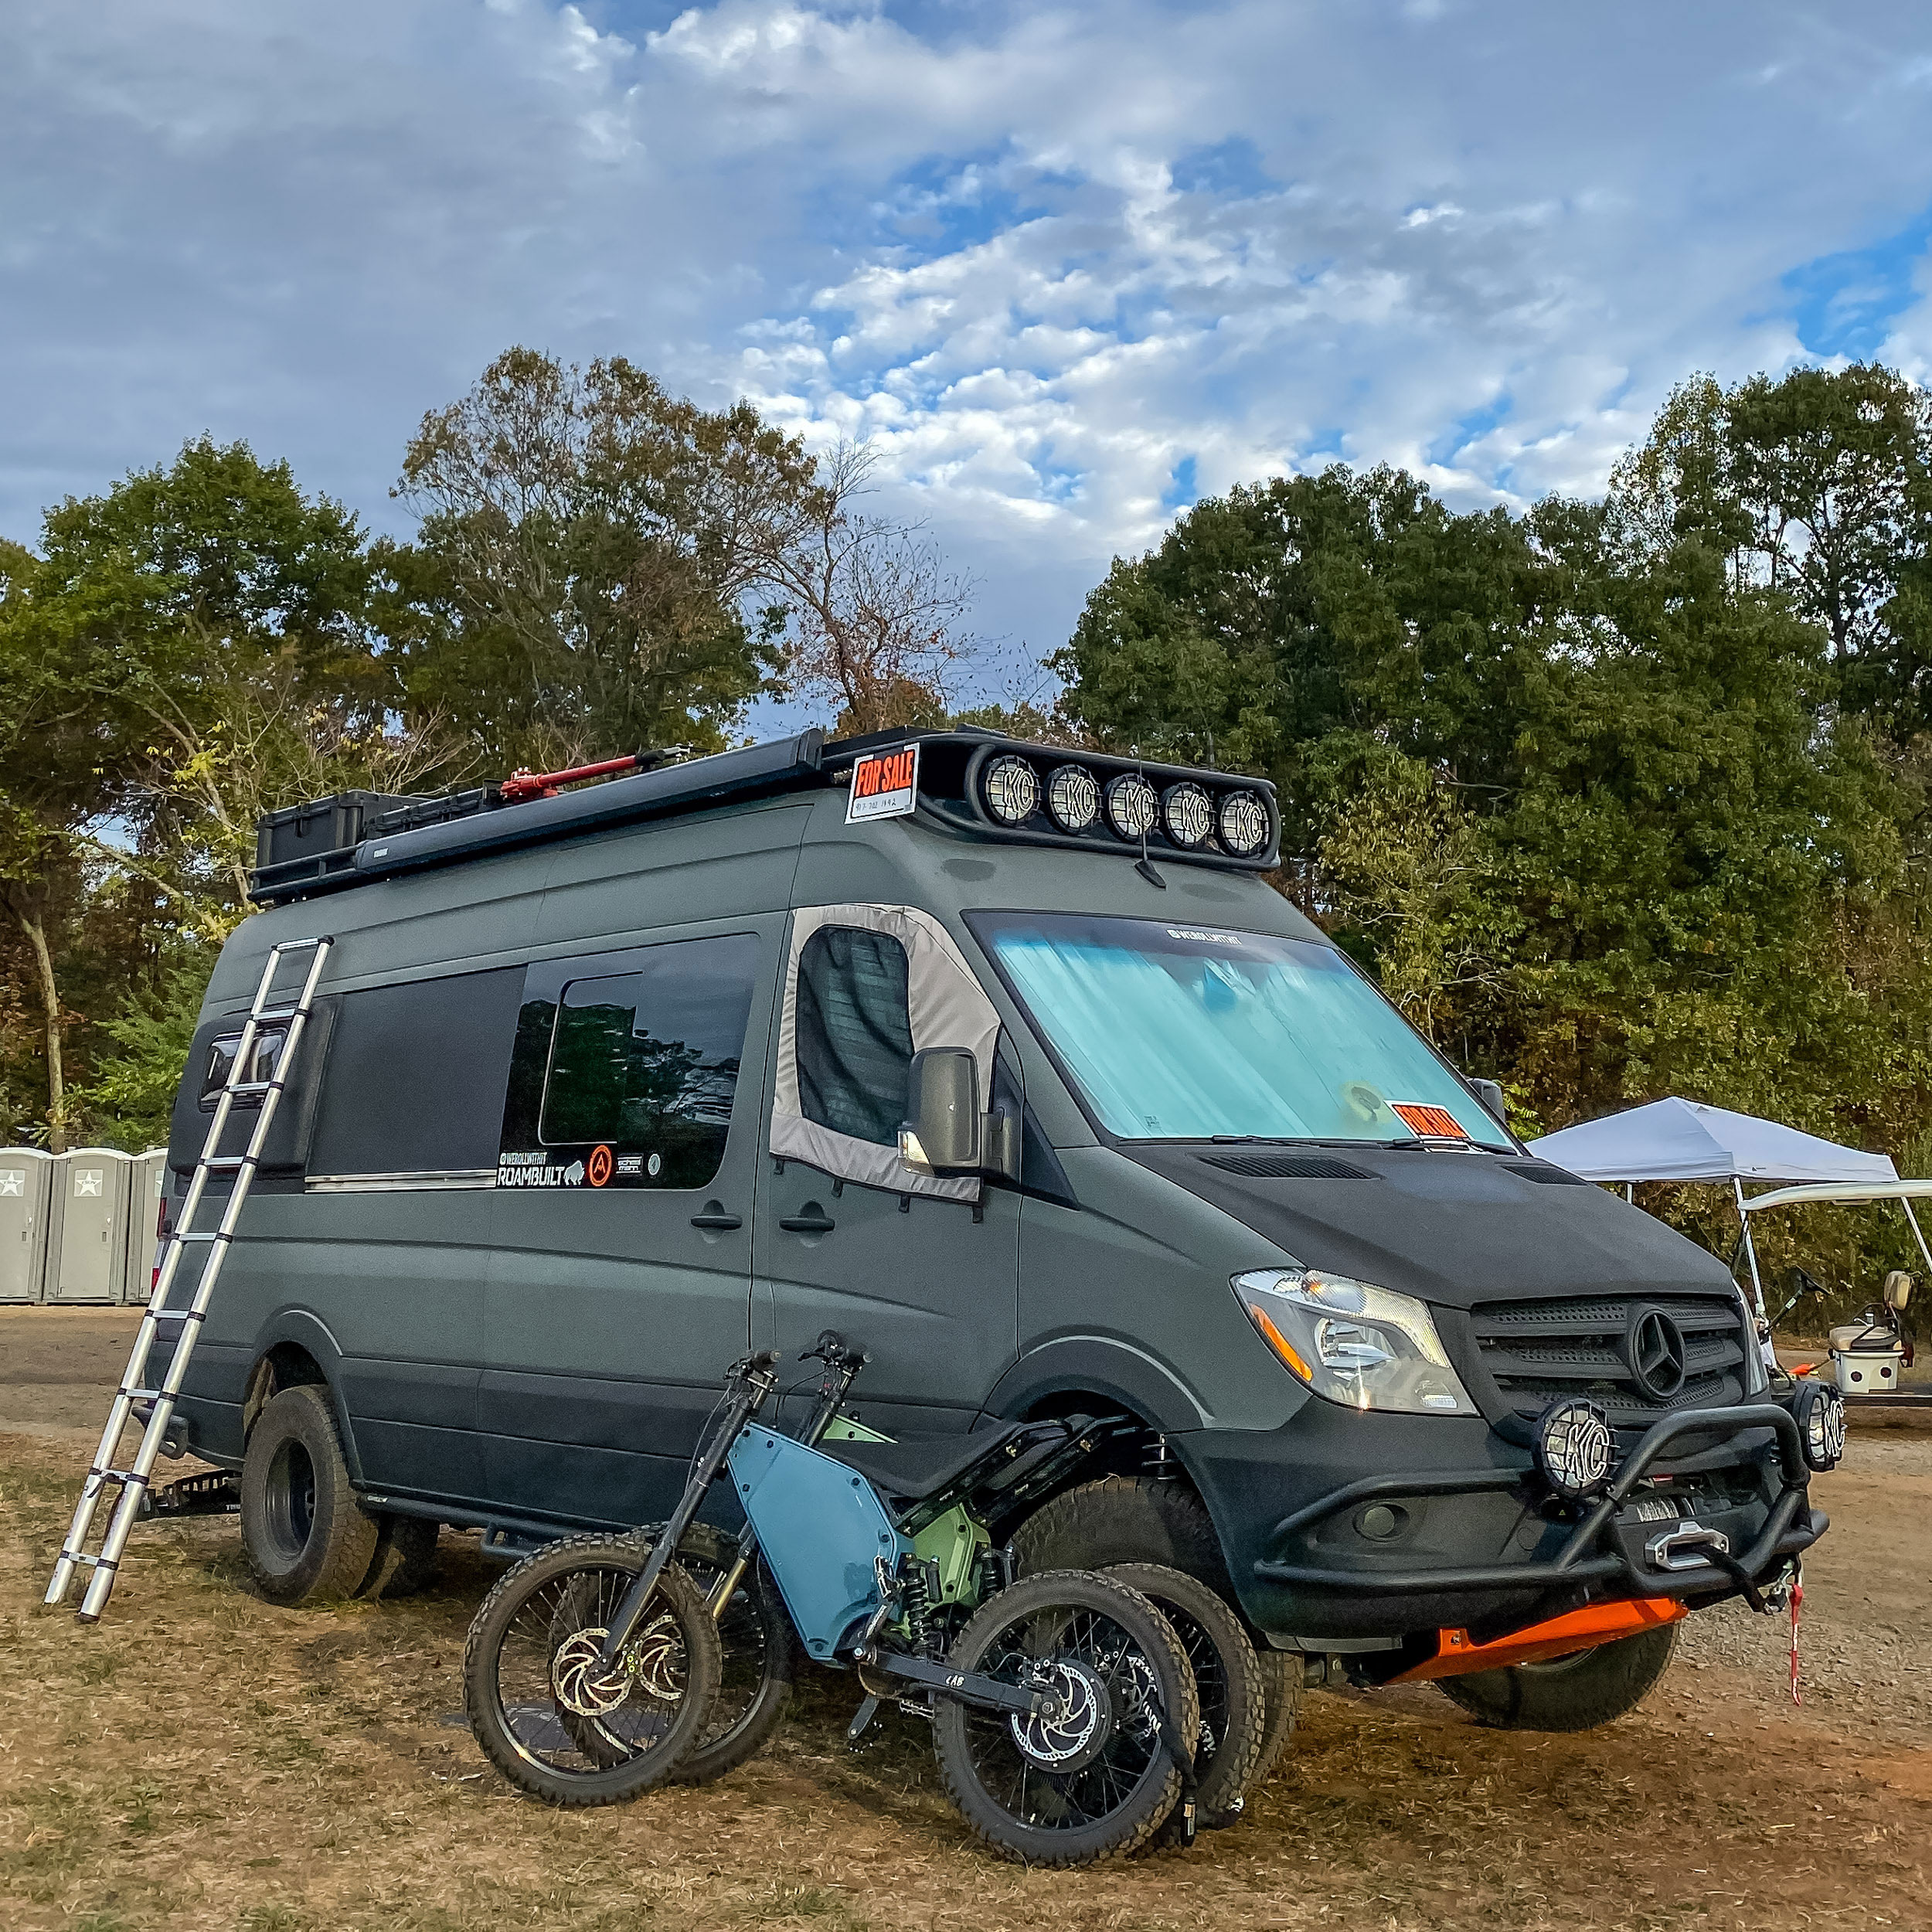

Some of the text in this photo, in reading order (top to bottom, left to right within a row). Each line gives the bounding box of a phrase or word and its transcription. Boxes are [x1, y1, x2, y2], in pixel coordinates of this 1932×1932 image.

[855, 750, 913, 797] FOR SALE
[1004, 767, 1035, 815] KC
[1066, 776, 1096, 820] KC
[1125, 784, 1154, 828] KC
[1182, 793, 1209, 835] KC
[1236, 802, 1263, 845] KC
[497, 1166, 565, 1186] ROAMBUILT
[1565, 1419, 1610, 1481] KC
[1824, 1400, 1845, 1458] KC
